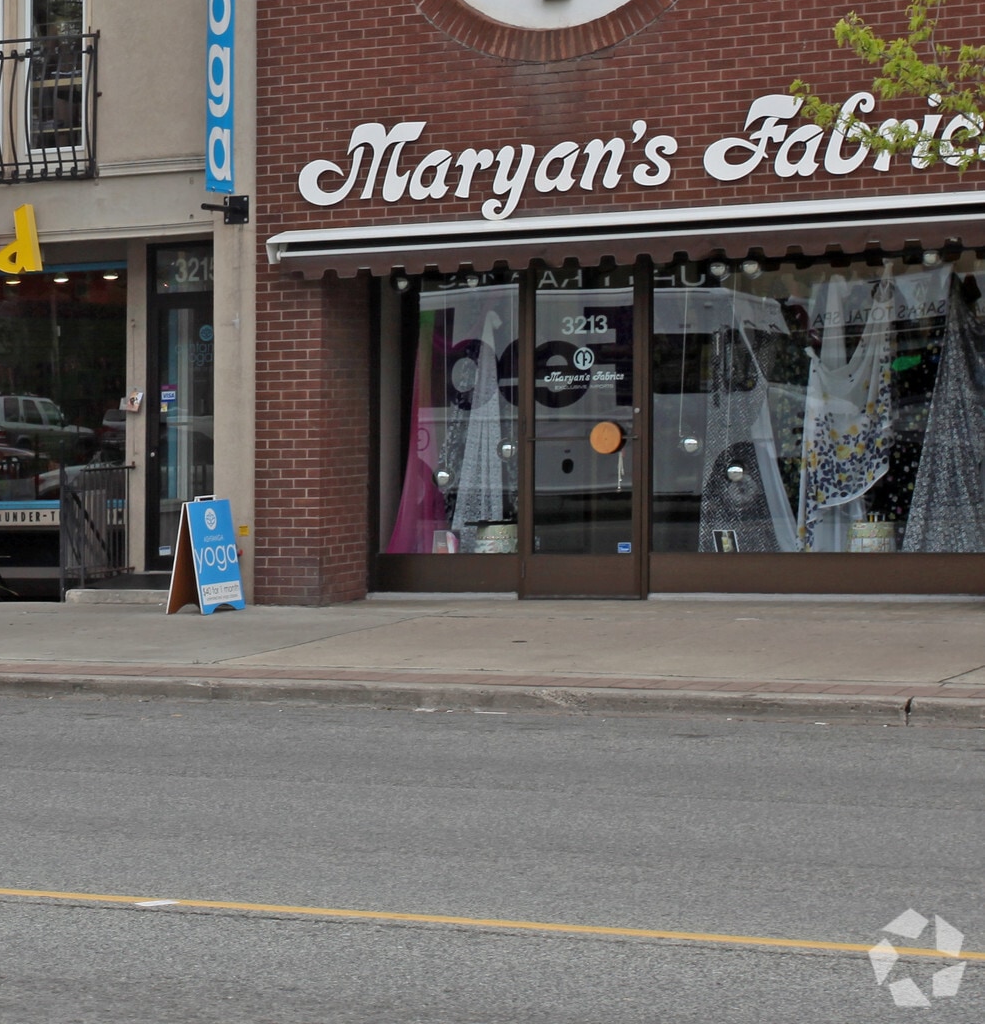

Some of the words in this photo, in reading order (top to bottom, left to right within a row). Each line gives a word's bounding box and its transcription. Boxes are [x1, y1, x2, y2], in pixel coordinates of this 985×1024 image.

[298, 120, 678, 221] Maryan's
[561, 314, 608, 335] 3213
[543, 371, 591, 385] Maryan's
[592, 370, 625, 381] Fabrics
[194, 543, 239, 575] yoga
[212, 586, 220, 594] for
[224, 584, 239, 593] month
